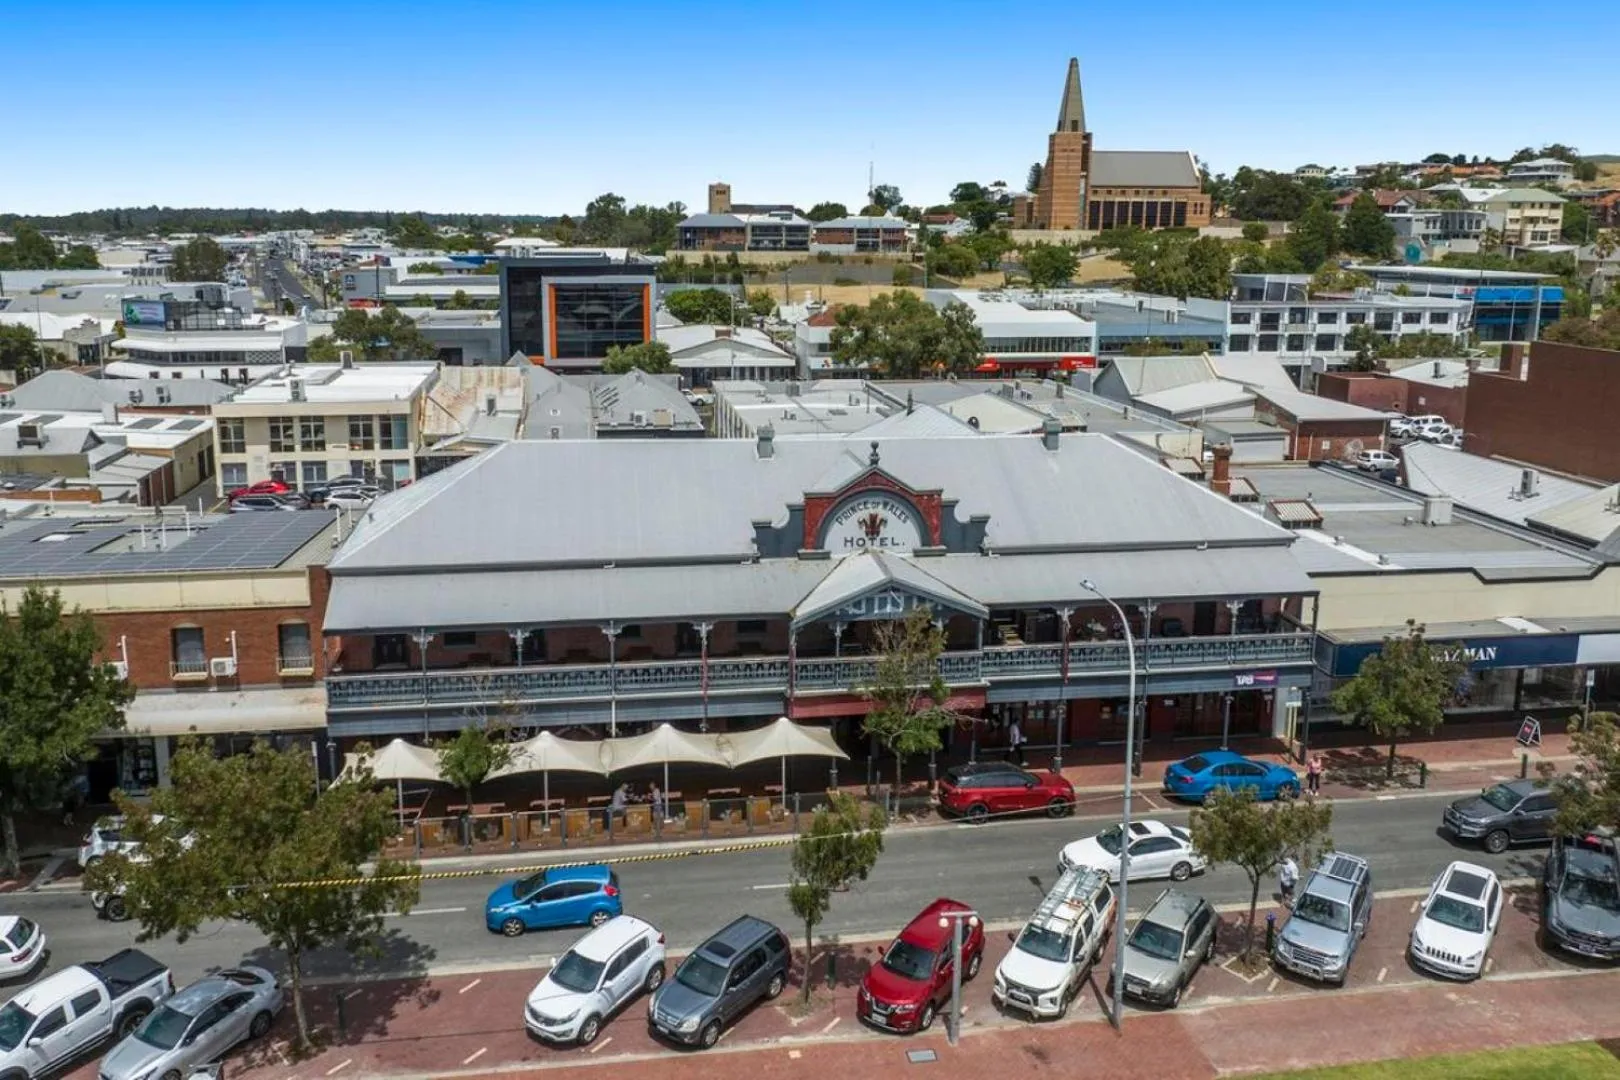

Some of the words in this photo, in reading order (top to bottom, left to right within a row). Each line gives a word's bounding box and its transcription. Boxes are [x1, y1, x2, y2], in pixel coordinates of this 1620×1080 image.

[836, 501, 869, 526] PRINCE
[869, 501, 880, 509] OF
[882, 501, 910, 524] WALES
[1235, 674, 1254, 685] TAB
